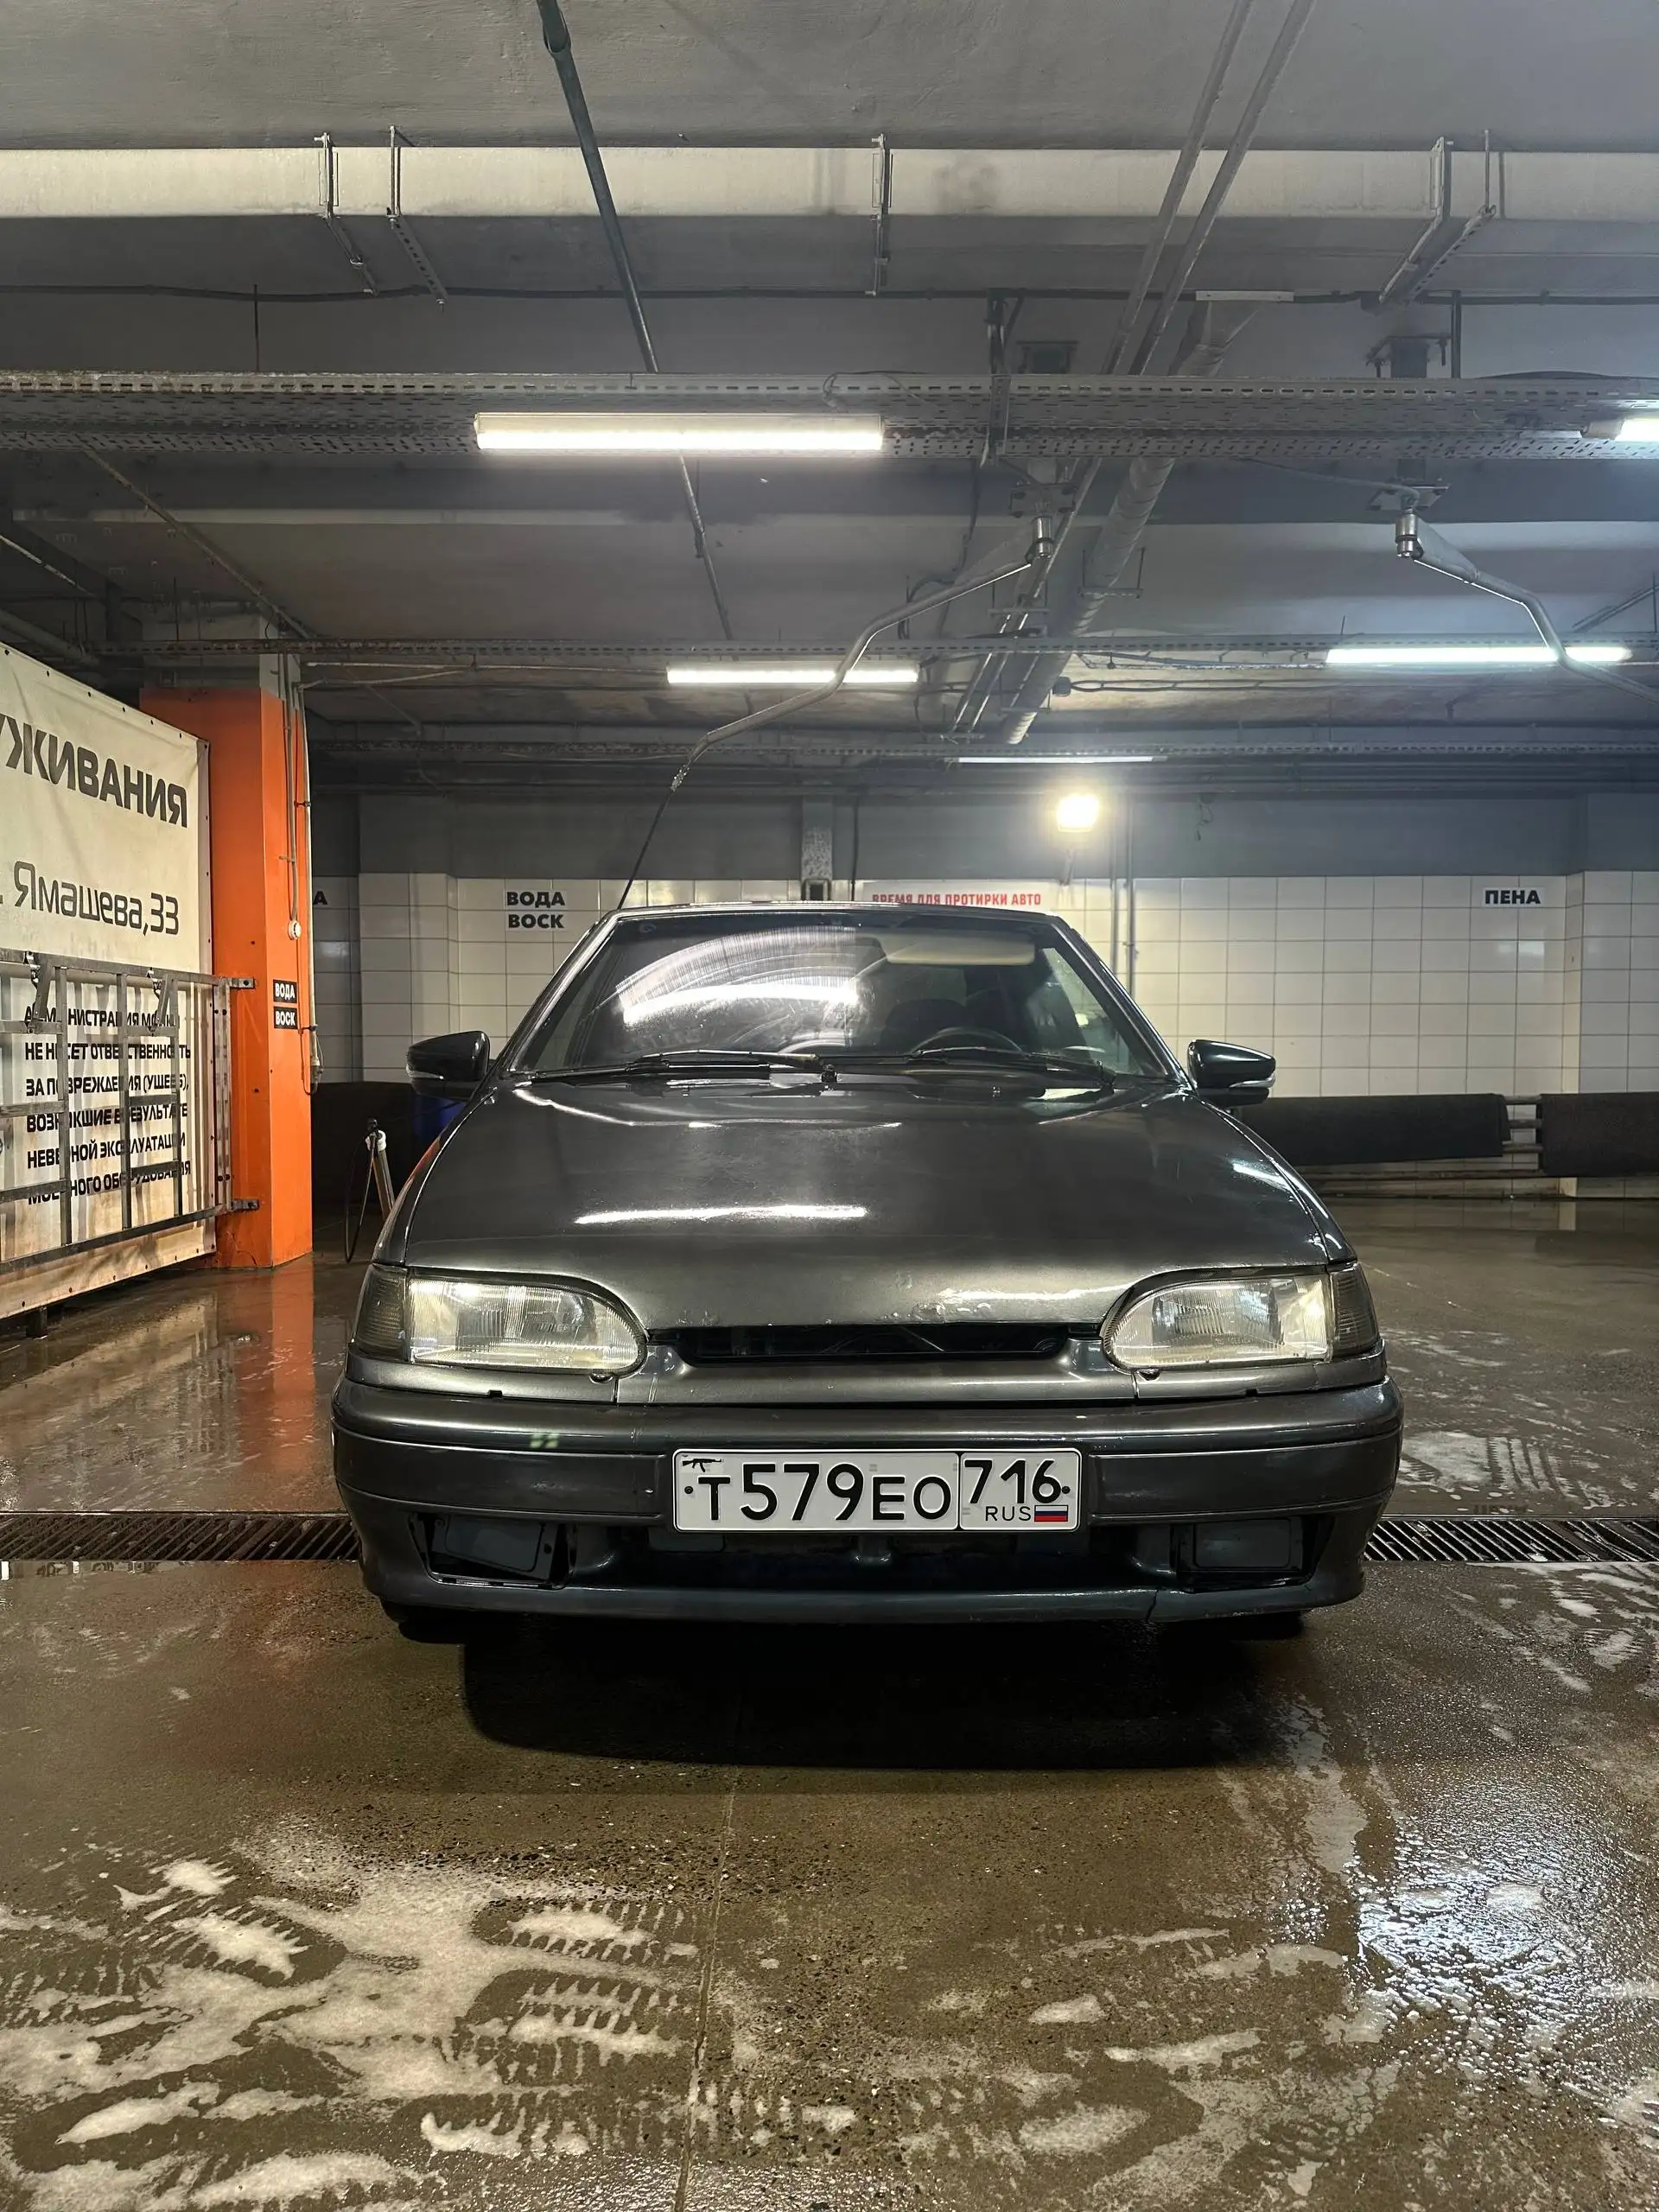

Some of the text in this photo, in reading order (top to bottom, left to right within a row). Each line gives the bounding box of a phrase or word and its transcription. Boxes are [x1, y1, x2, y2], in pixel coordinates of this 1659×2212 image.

[0, 714, 188, 828] ЖИВАНИЯ
[14, 861, 179, 936] Ямашева,33
[506, 892, 565, 908] ВОДА
[918, 894, 940, 905] ДЛЯ
[945, 893, 1007, 906] ПРОТИРКИ
[1012, 893, 1041, 906] АВТО
[1485, 890, 1541, 904] ПЕНА
[508, 914, 564, 929] ВОСК
[275, 982, 296, 1001] ВОДА
[275, 1011, 296, 1026] ВОСК
[25, 1042, 191, 1060] НЕ НЕТ ОТВЕСТВЕННОТЬ
[26, 1077, 45, 1096] ЗА
[47, 1075, 141, 1096] ПВРЕЖДЕИЯ
[27, 1132, 186, 1169] НЕВЕНОЙ ЭКСЛУАТАЦИ
[964, 1459, 1061, 1503] 716
[985, 1505, 1031, 1521] RUS
